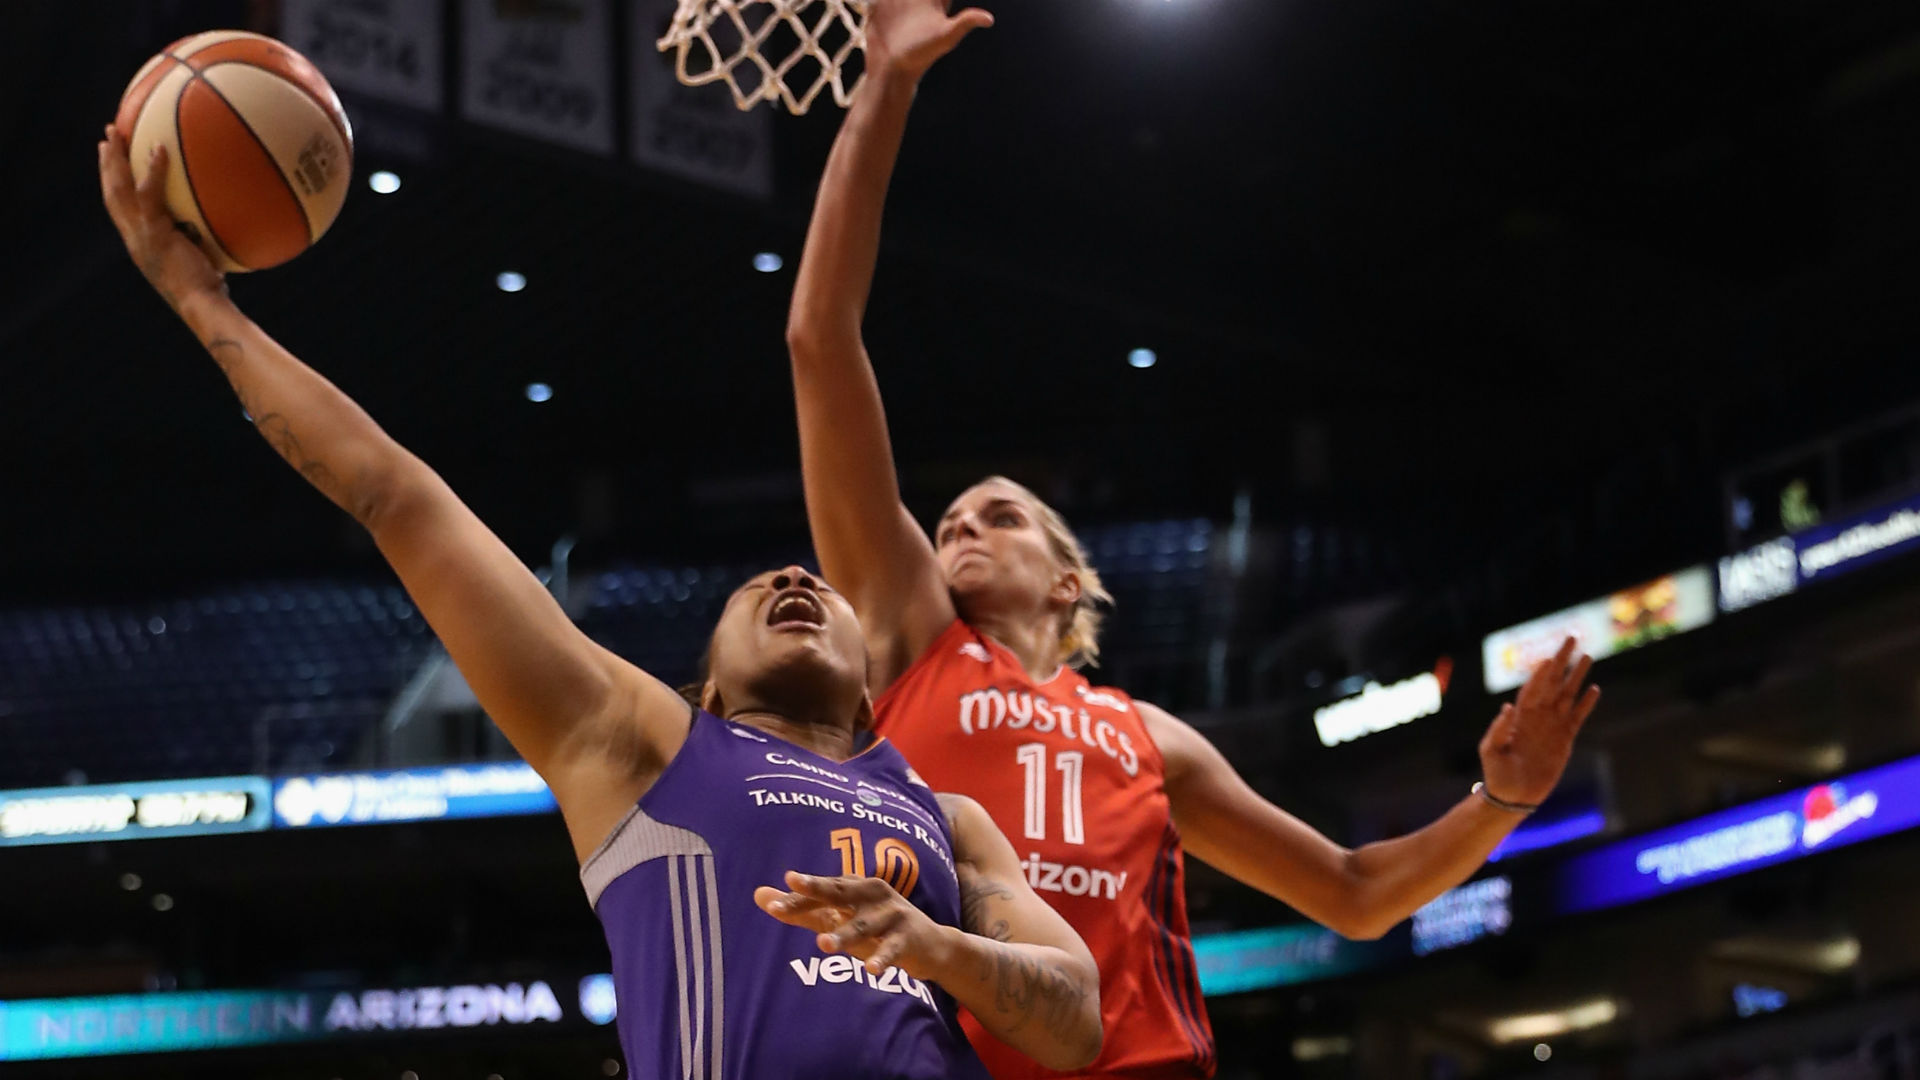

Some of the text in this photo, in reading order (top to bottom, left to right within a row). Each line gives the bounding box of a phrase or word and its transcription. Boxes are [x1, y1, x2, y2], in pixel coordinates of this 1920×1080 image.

[749, 789, 845, 814] TALKING
[852, 803, 911, 834] STICK
[1017, 743, 1084, 845] 11
[1021, 853, 1117, 899] izon
[325, 981, 563, 1031] ARIZONA
